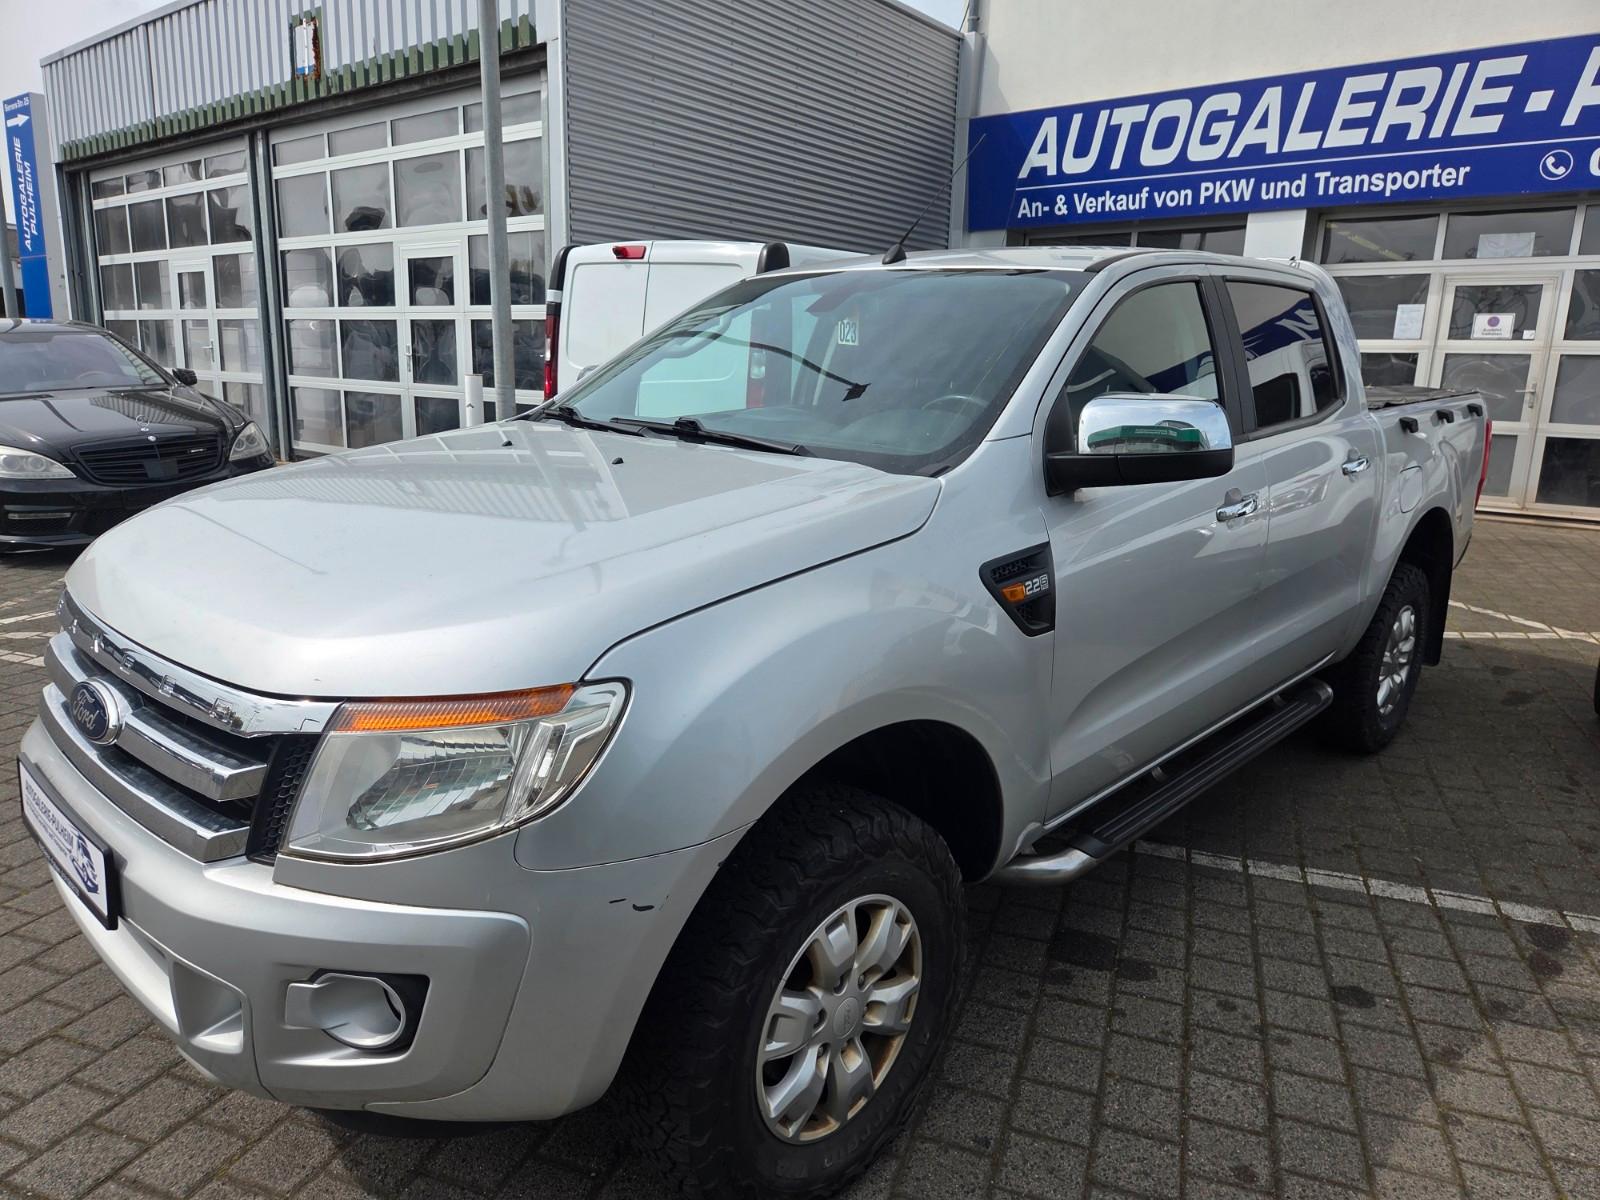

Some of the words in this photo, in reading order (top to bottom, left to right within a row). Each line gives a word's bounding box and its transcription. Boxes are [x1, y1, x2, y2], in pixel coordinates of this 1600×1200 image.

[13, 136, 32, 251] AUTOGALERIE
[24, 161, 38, 236] PULHEIM
[1017, 197, 1050, 219] An-
[1055, 194, 1068, 216] &
[1073, 187, 1149, 214] Verkauf
[1154, 188, 1192, 208] von
[1200, 177, 1255, 205] PKW
[1261, 173, 1306, 201] und
[1314, 163, 1471, 197] Transporter
[840, 320, 857, 344] 023
[73, 688, 100, 730] Ford
